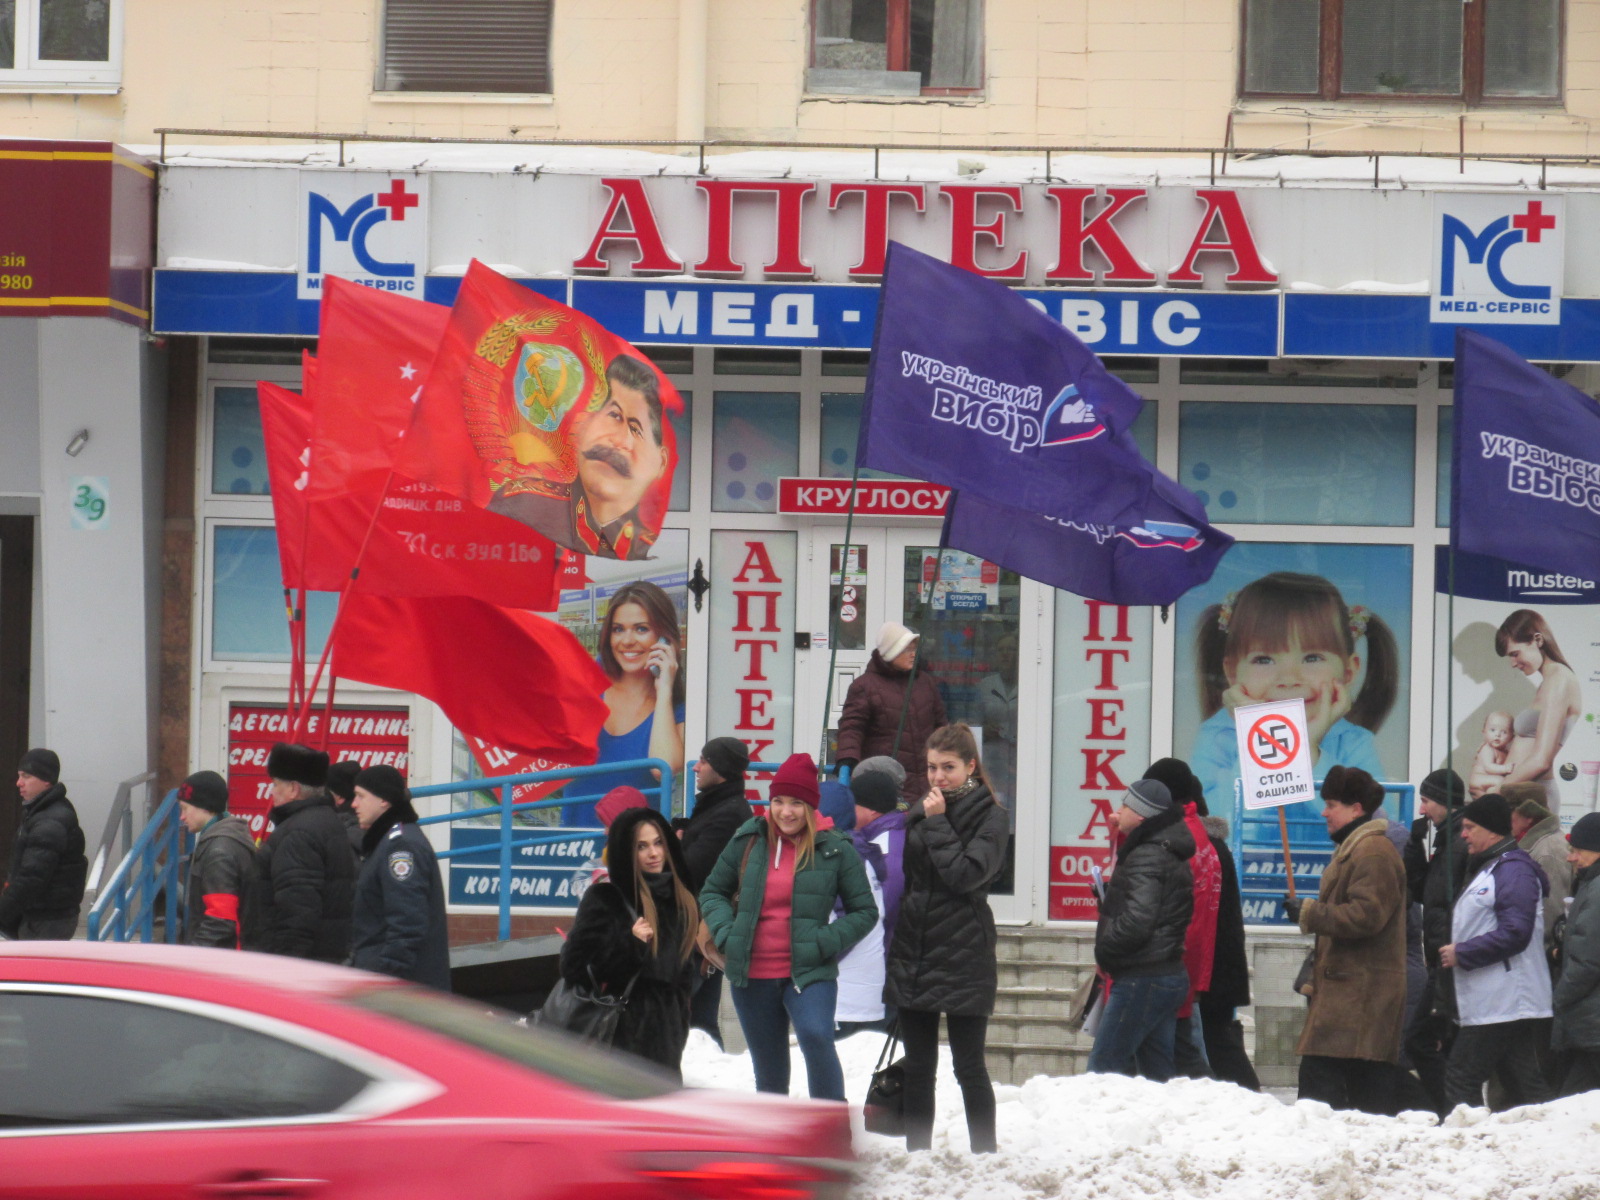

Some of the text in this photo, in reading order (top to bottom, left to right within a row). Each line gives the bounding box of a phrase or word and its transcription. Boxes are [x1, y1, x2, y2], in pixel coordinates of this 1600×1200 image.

[573, 177, 1279, 284] АПТЕКА
[1440, 300, 1551, 314] МЕД-СЕРВІС
[902, 351, 1042, 412] український
[932, 387, 1042, 453] вибір
[74, 484, 106, 521] 39
[1079, 599, 1133, 841] ПТЕКА
[1256, 784, 1307, 799] ФАШИЗМ!
[1260, 771, 1293, 785] СТОП
[465, 876, 552, 897] КОТРЫМ
